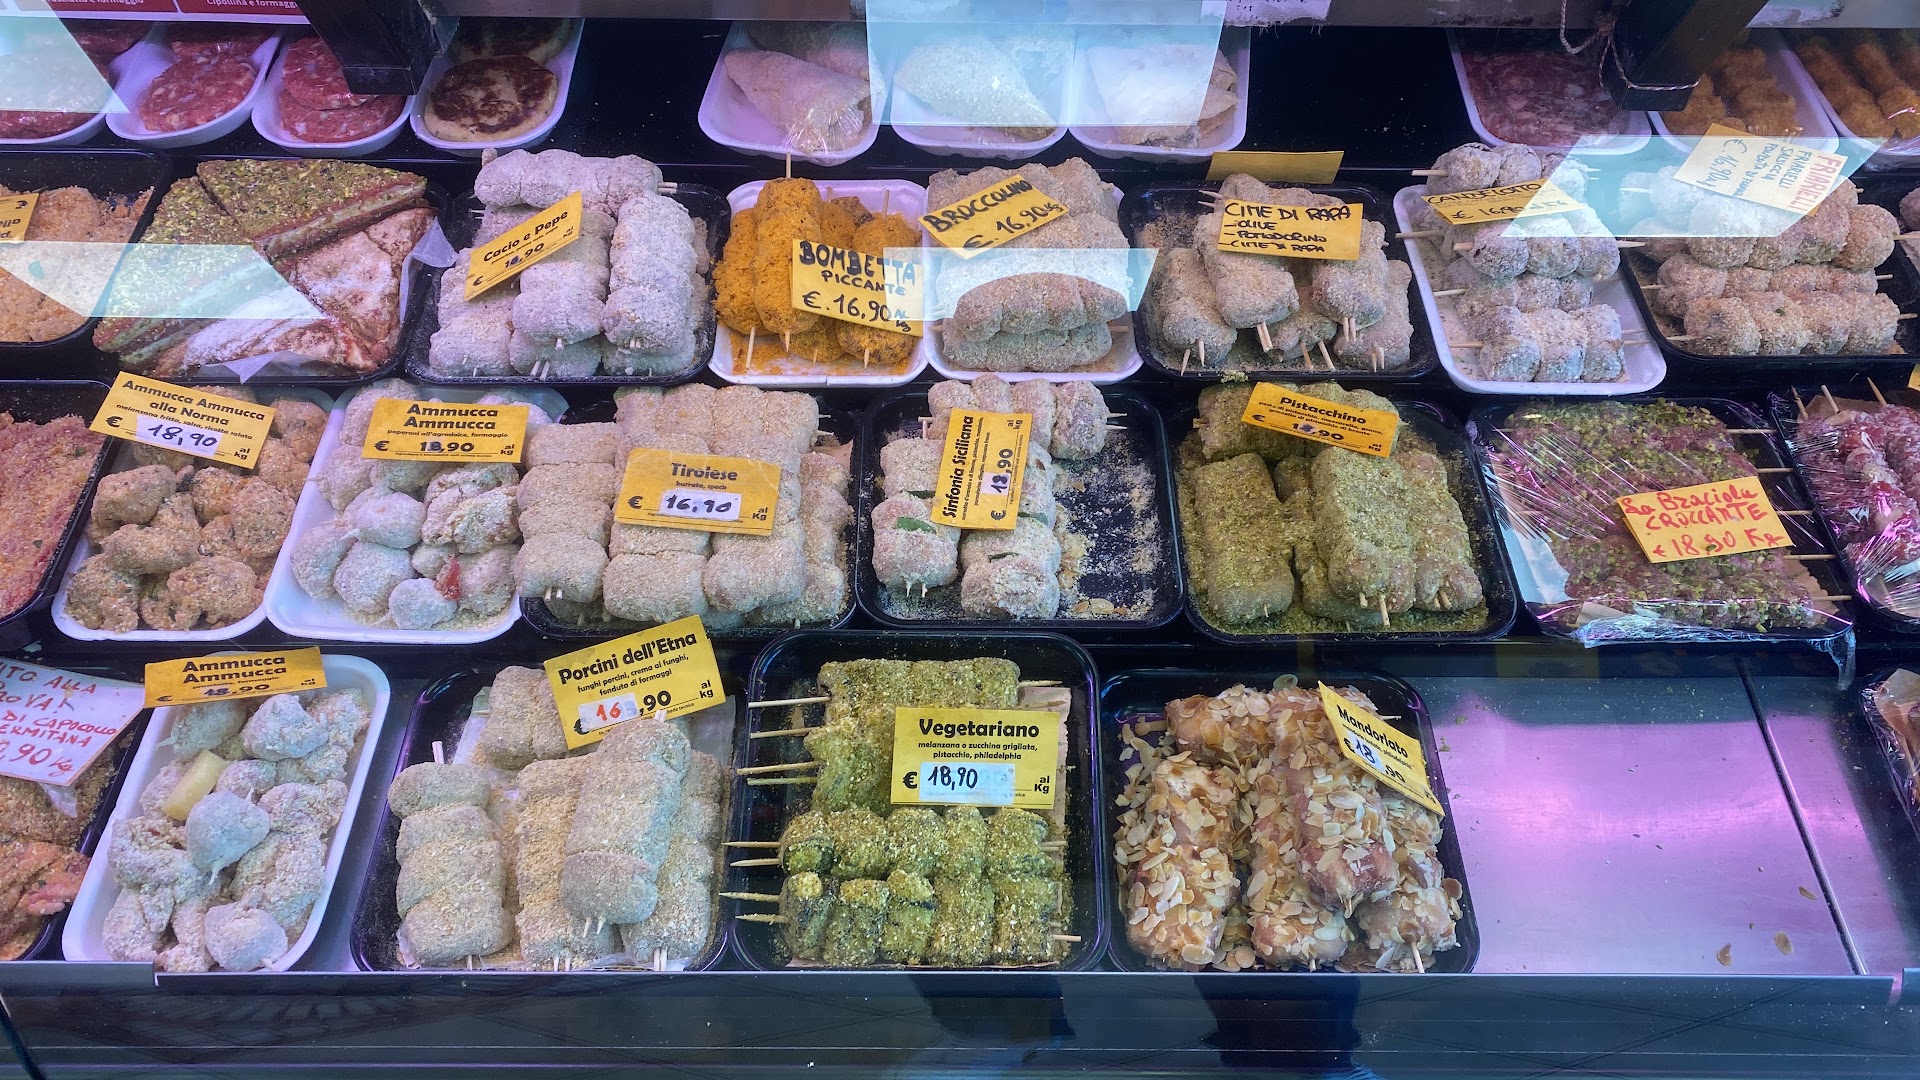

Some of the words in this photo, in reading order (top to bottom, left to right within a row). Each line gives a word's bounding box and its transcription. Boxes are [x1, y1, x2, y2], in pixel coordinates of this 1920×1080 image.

[1779, 150, 1812, 189] FRIARIELLI
[1787, 155, 1842, 211] FRIARIELLI
[1428, 183, 1542, 204] CANDELOTTO
[1225, 202, 1273, 218] CIME
[1277, 208, 1299, 220] DI
[1305, 206, 1352, 221] RAPA
[484, 240, 520, 262] Cacio
[534, 212, 568, 236] Pepe
[1290, 244, 1325, 252] RAPA
[799, 240, 916, 286] BOMBETTA
[472, 276, 484, 286] €
[822, 270, 906, 296] PICCANTE
[122, 380, 193, 404] Ammucca
[196, 398, 265, 420] Ammucca
[150, 402, 177, 414] alla
[181, 406, 229, 426] Norma
[406, 404, 498, 417] Ammucca
[1252, 414, 1266, 422] €
[1280, 396, 1366, 424] Pistacchino
[106, 416, 123, 428] €
[148, 424, 218, 446] 18,90
[404, 416, 496, 430] Ammucca
[1014, 420, 1024, 430] kg
[240, 446, 250, 454] al
[374, 440, 390, 452] €
[952, 416, 974, 466] Siciliana
[234, 452, 248, 460] kg
[990, 448, 1014, 493] 18,90
[942, 467, 964, 518] Sinfonia
[1656, 484, 1758, 511] Braciola
[628, 496, 644, 509] €
[990, 510, 1006, 520] €
[182, 656, 286, 672] Ammucca
[558, 654, 619, 684] Porcini
[622, 633, 697, 665] dell'Etna
[182, 667, 287, 684] Ammucca
[577, 680, 601, 693] funghi
[602, 672, 630, 686] porcini,
[630, 666, 653, 676] crema
[654, 661, 662, 670] ai
[663, 654, 689, 669] funghi,
[600, 682, 629, 696] fonduta
[630, 678, 638, 686] di
[640, 668, 672, 684] formaggi
[44, 675, 97, 694] ALLA
[698, 688, 714, 700] kg
[700, 680, 711, 690] al
[0, 724, 92, 748] ERMITANA
[32, 718, 117, 735] CAPOCOLLO
[919, 718, 1040, 738] Vegetariano
[1337, 705, 1408, 758] Mandorlato
[968, 742, 1000, 750] zucchina
[1002, 742, 1038, 751] grigliata,
[1344, 738, 1356, 753] €
[933, 751, 972, 759] pistacchio,
[974, 752, 1022, 760] philadelphia
[902, 772, 918, 789] €
[928, 766, 978, 790] 18,90
[1039, 776, 1050, 784] al
[1034, 784, 1050, 794] Kg
